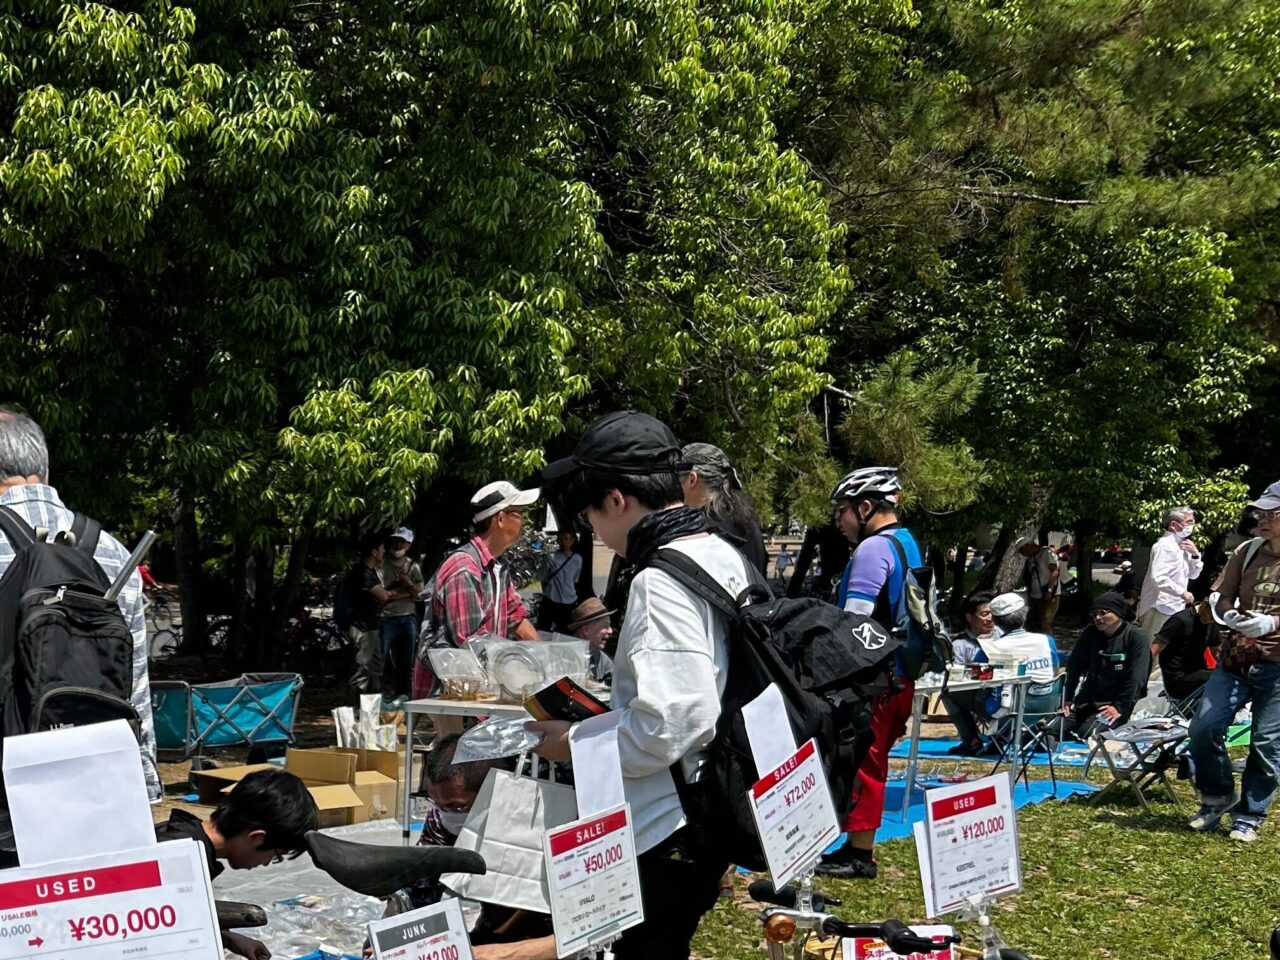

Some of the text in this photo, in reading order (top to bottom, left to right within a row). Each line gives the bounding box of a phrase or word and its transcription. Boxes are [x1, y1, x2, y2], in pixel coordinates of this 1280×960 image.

[773, 755, 798, 781] SALE!
[784, 772, 816, 807] ¥72,000
[953, 796, 975, 810] USED
[576, 823, 605, 843] SALE!
[962, 815, 1005, 840] ¥120,000
[583, 843, 623, 874] ¥50,000
[35, 876, 97, 899] USED
[67, 904, 177, 941] ¥30,000
[402, 922, 427, 940] JUNK
